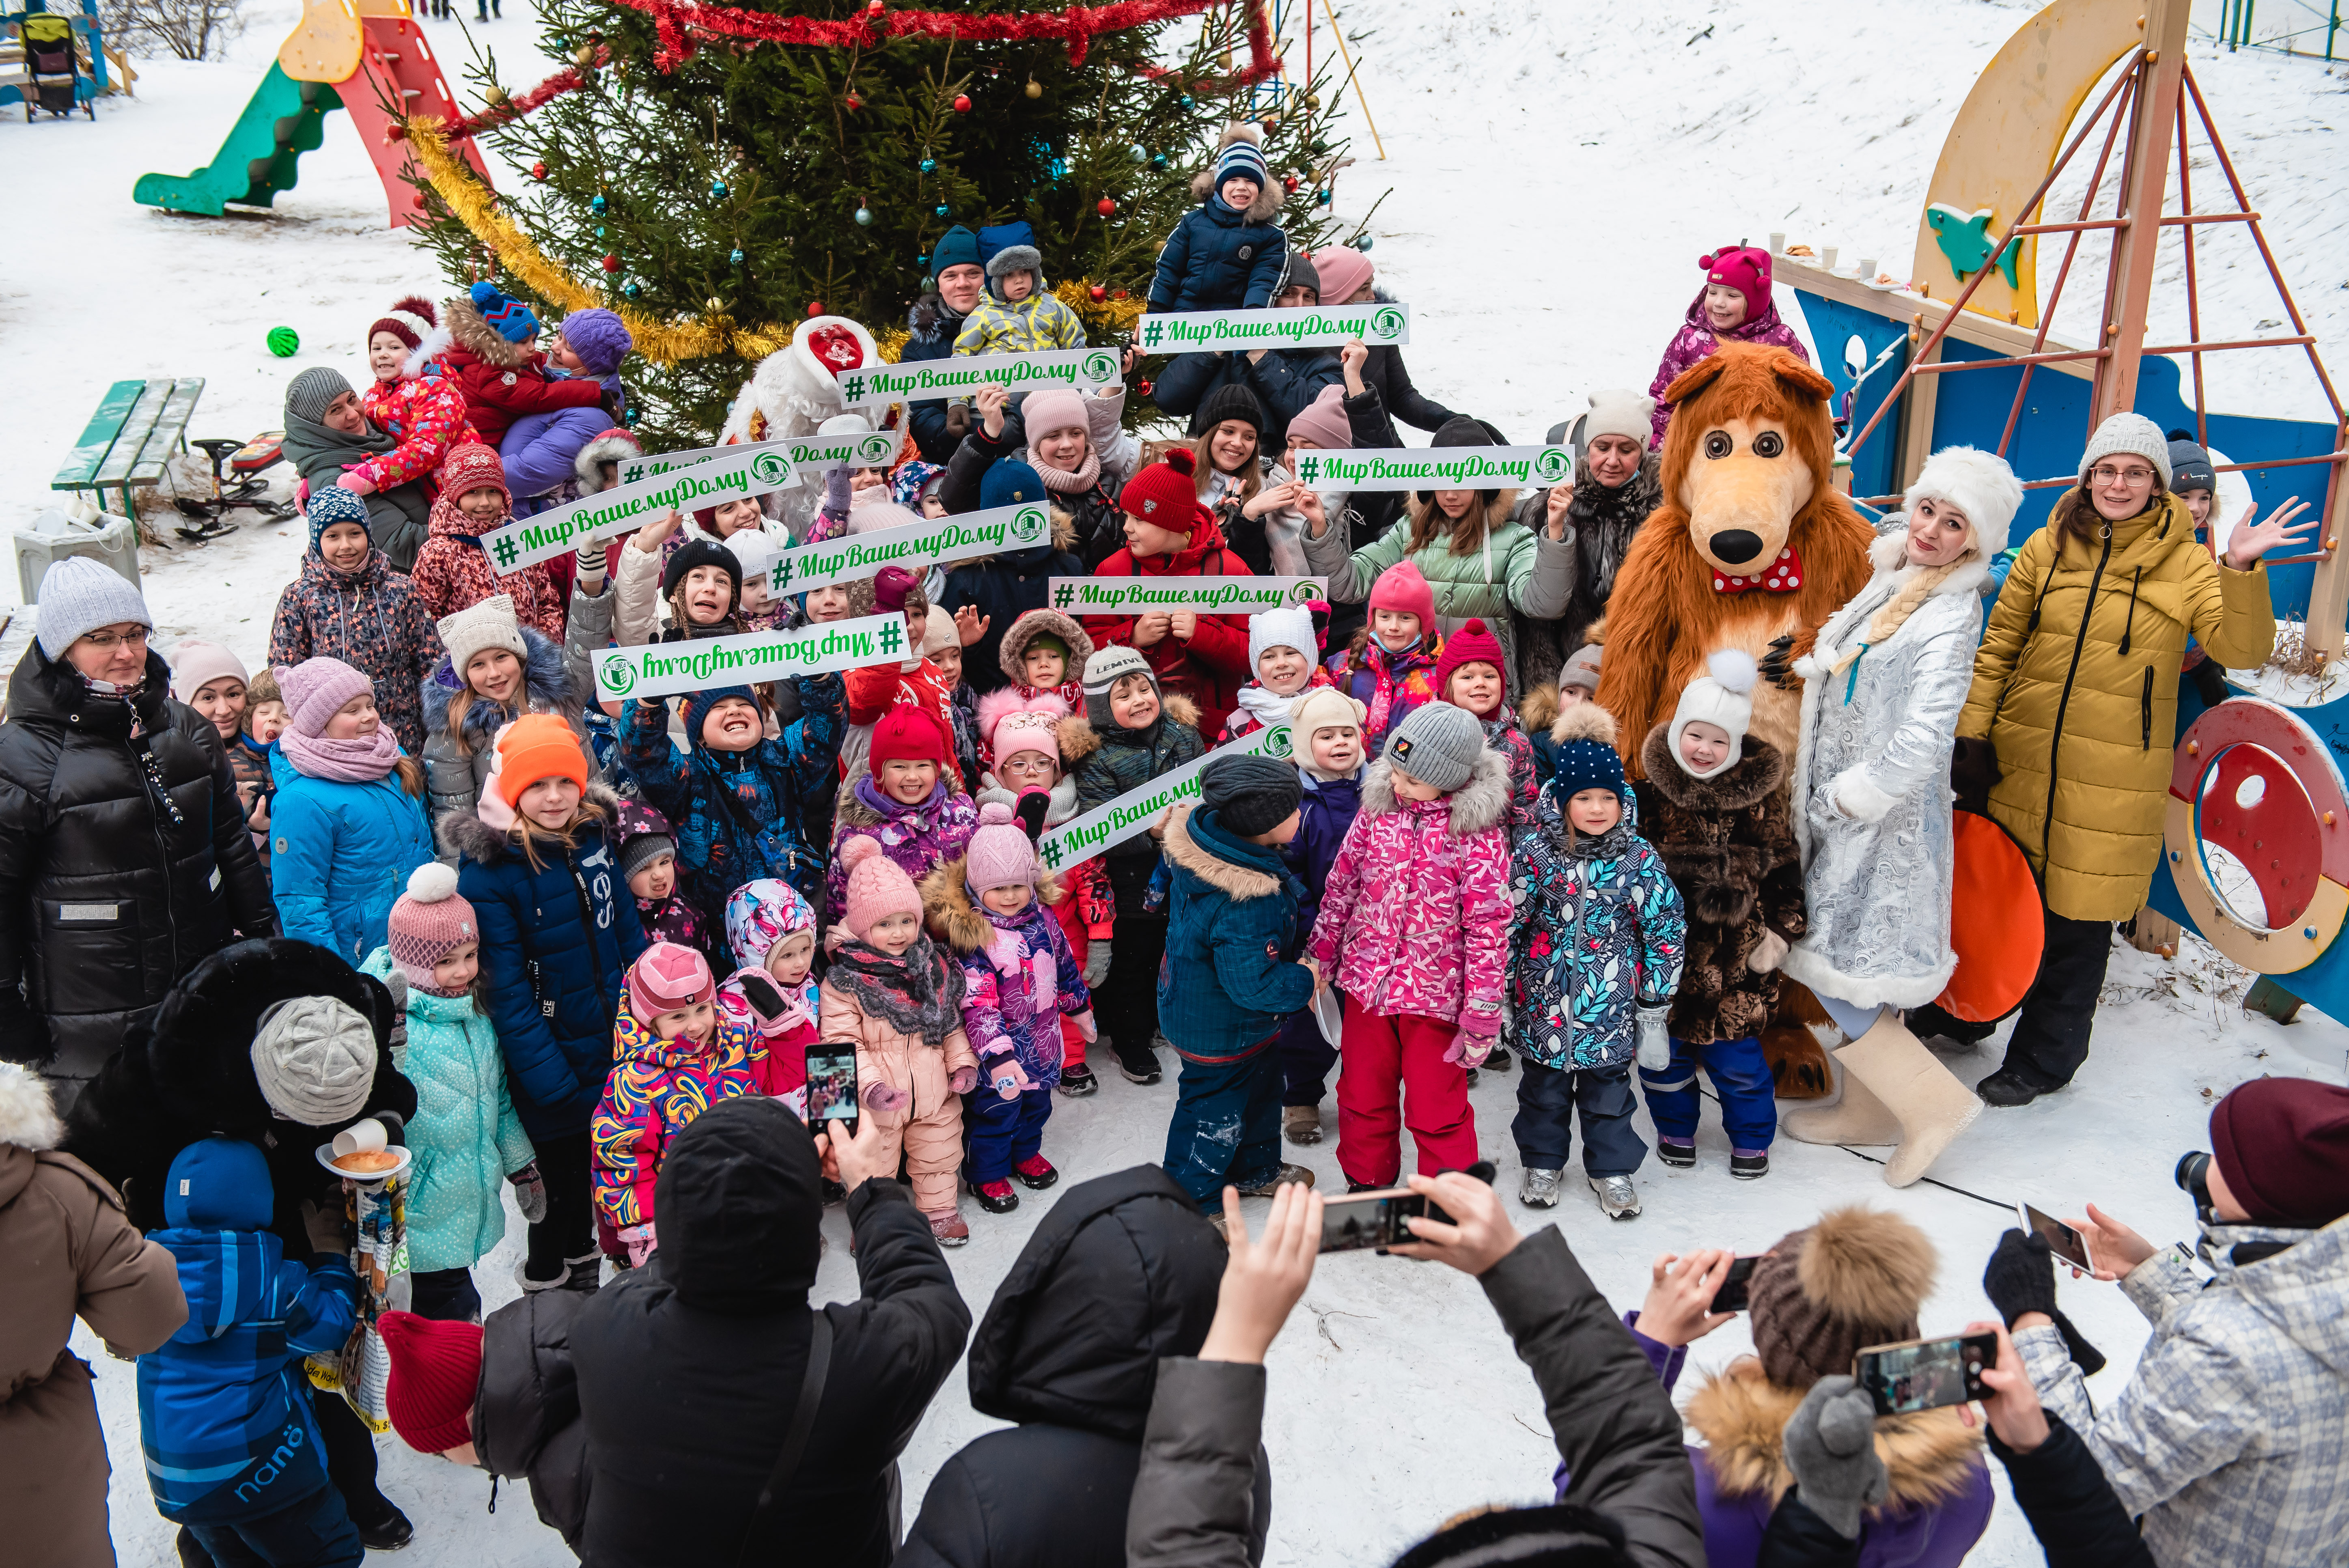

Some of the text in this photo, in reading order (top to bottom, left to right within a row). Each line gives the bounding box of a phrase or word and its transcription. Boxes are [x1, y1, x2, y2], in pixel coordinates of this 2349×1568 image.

[1144, 314, 1366, 347] #МирВашемуДому
[845, 364, 1077, 402] #МирВашемуДому
[1300, 455, 1530, 485] #МирВашемуДому
[492, 470, 748, 567] #МирВашемуДому
[772, 523, 1006, 590] #МирВашемуДому
[1055, 584, 1284, 608] #МирВашемуДому
[643, 621, 903, 680] #МирВашемуДому
[1097, 657, 1142, 674] LEMIVE
[1392, 748, 1405, 760] Likee
[543, 1000, 552, 1017] ICE
[234, 1424, 303, 1503] nanö
